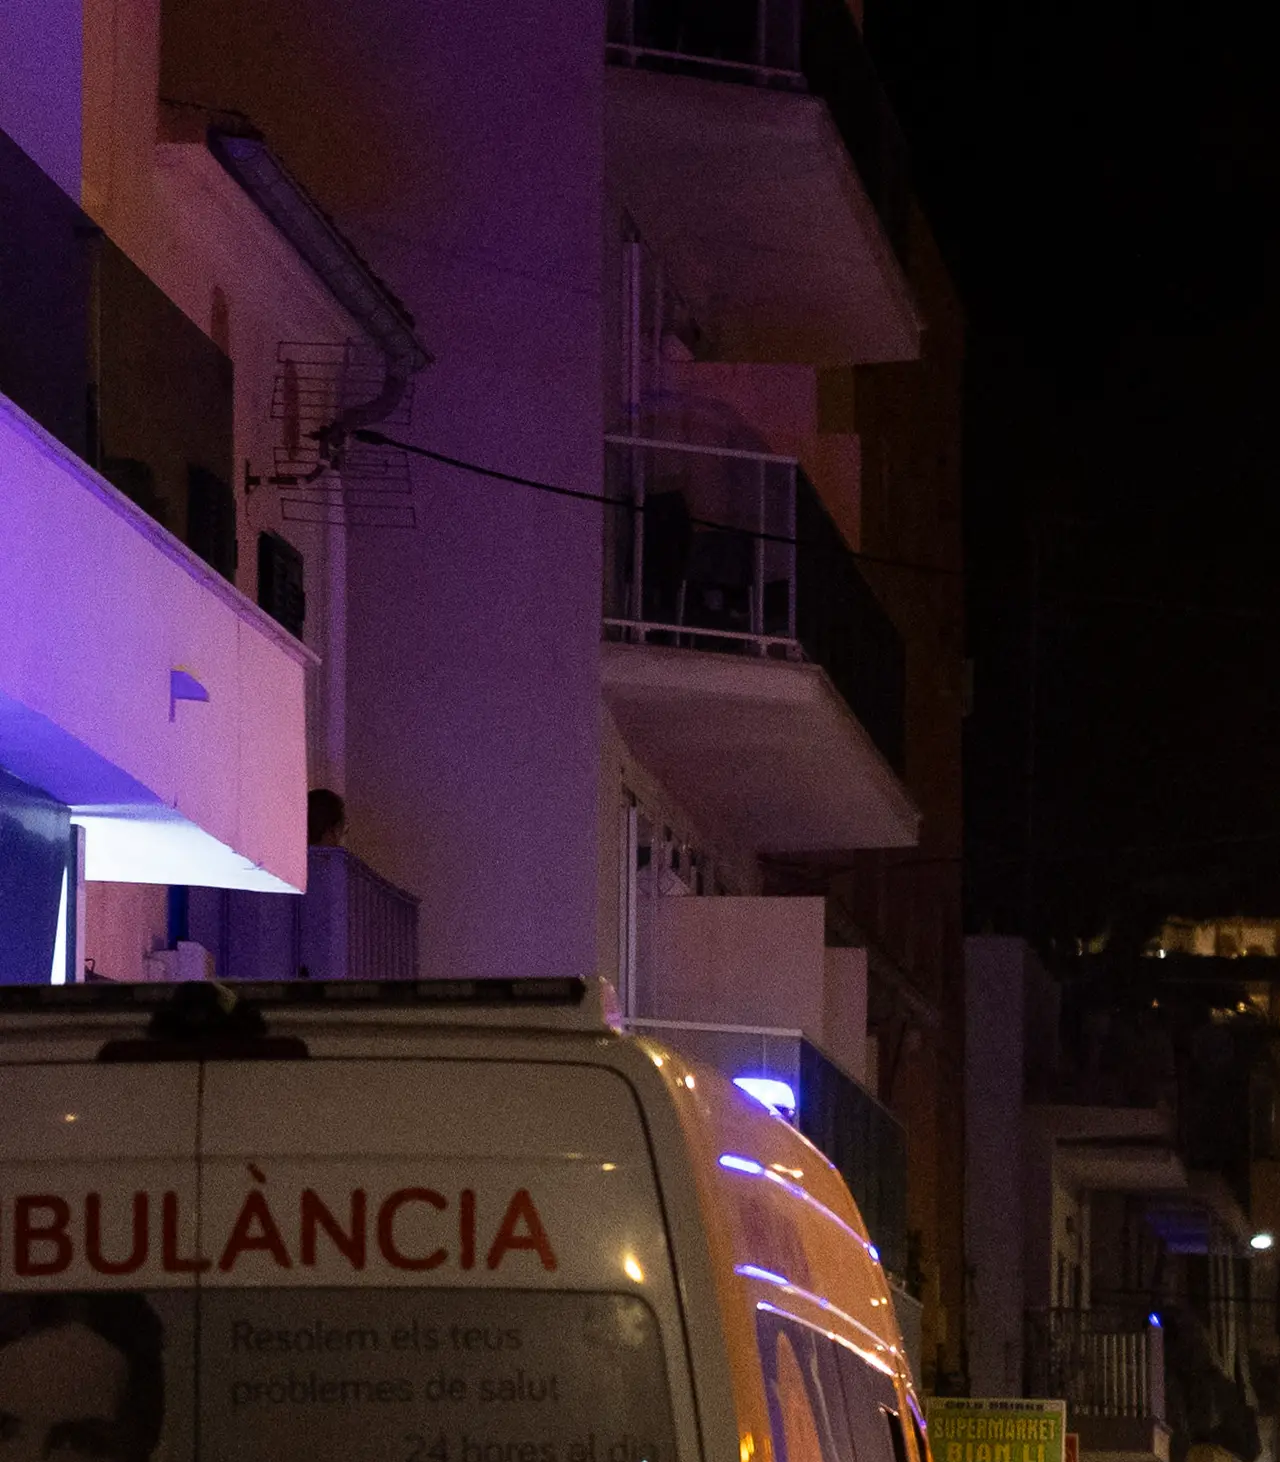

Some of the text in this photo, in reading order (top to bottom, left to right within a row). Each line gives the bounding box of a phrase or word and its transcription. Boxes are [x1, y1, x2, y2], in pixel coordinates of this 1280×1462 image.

[231, 1319, 523, 1353] Resolem els teus
[231, 1370, 560, 1413] problemes de salut
[934, 1417, 1057, 1440] SUPERMARKET
